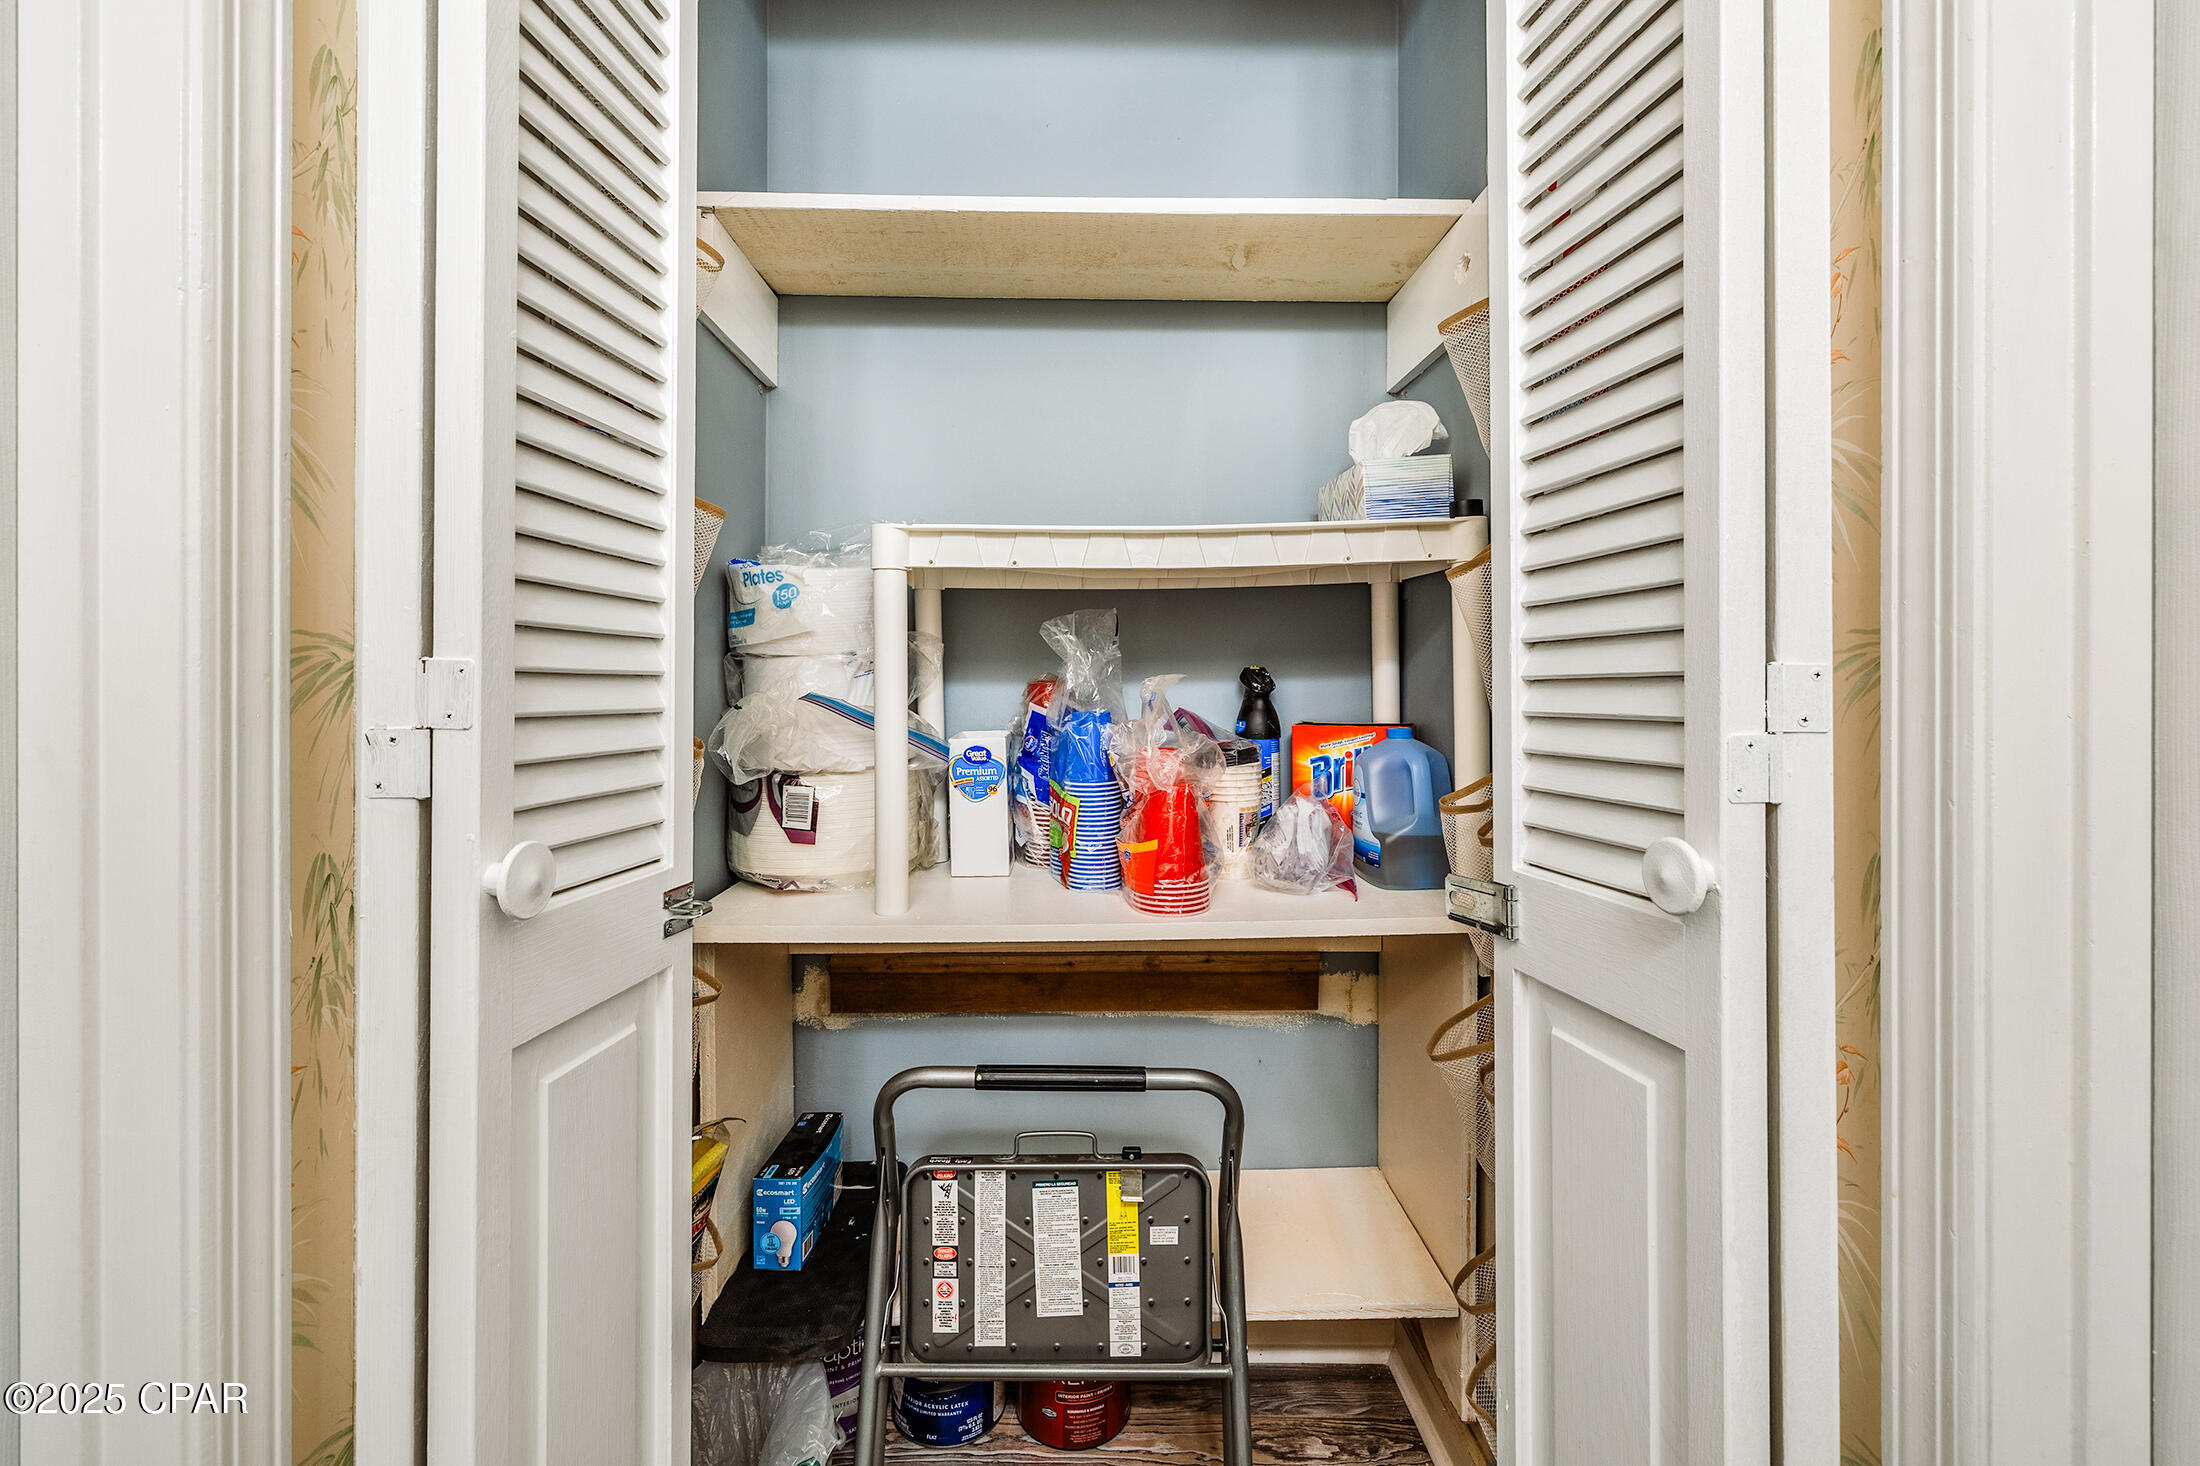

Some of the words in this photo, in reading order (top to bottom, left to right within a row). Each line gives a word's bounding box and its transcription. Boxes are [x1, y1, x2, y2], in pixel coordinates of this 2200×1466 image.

[742, 569, 784, 588] Plates
[775, 586, 798, 601] 150
[965, 749, 987, 758] Great
[956, 766, 998, 776] Premium
[987, 785, 998, 793] 96
[924, 1402, 949, 1410] ACRYLIC
[950, 1400, 969, 1409] LATEX
